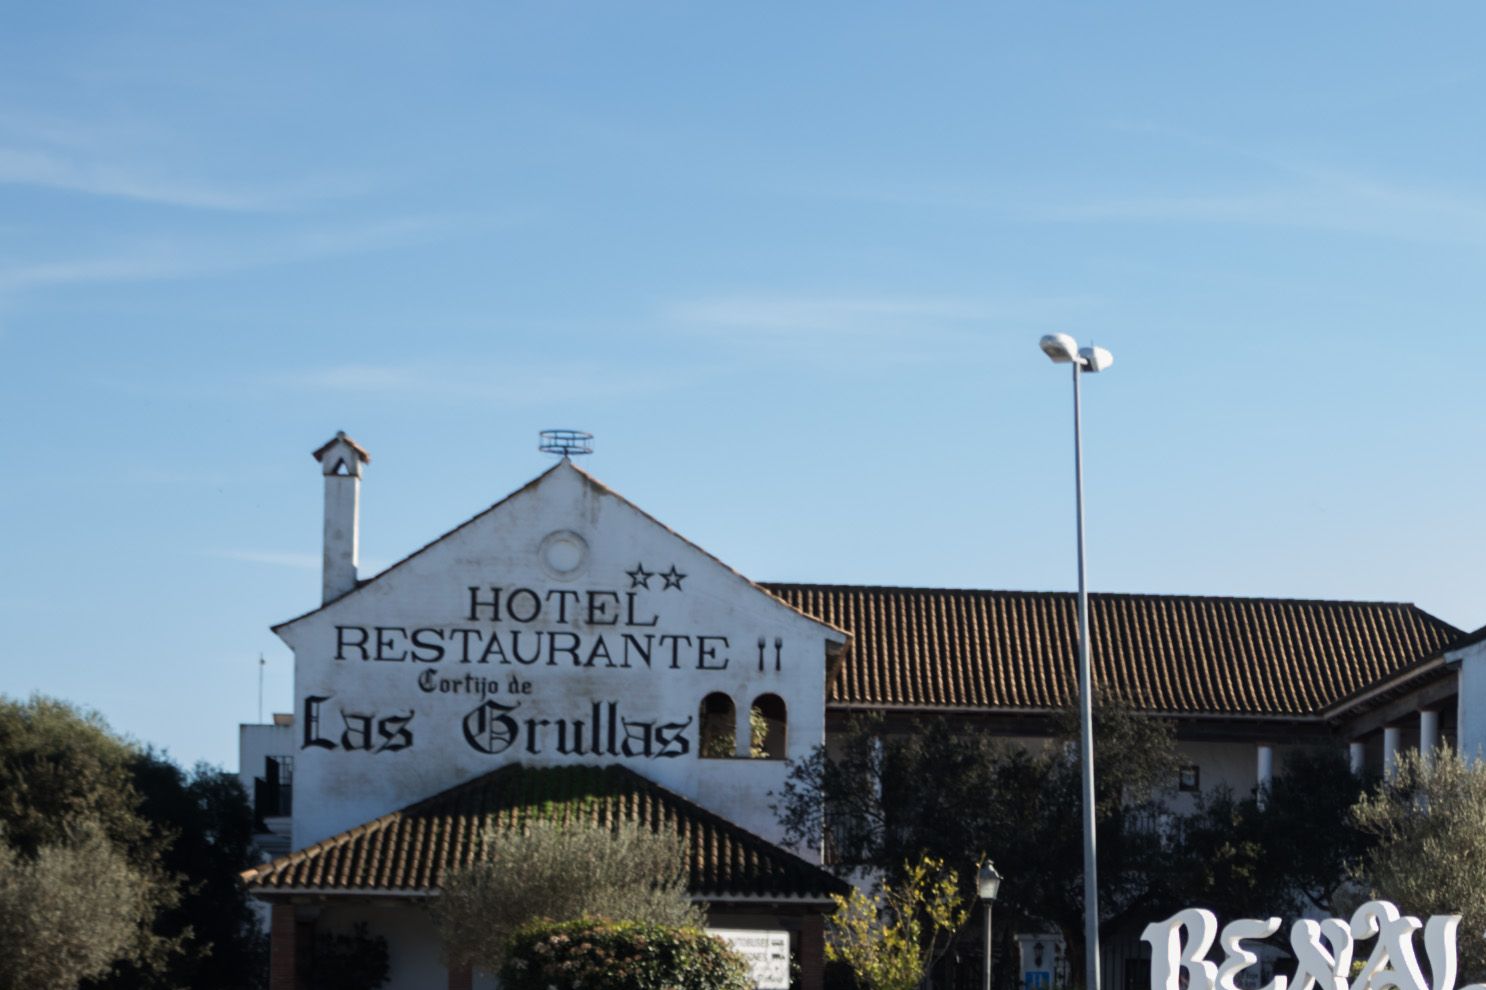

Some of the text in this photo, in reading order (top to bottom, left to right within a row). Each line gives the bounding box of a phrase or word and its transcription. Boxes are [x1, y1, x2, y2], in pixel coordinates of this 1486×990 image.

[467, 586, 660, 628] HOTEL
[333, 625, 731, 671] RESTAURANTE
[418, 669, 533, 701] Cortijo de
[301, 695, 693, 759] Las Grullas
